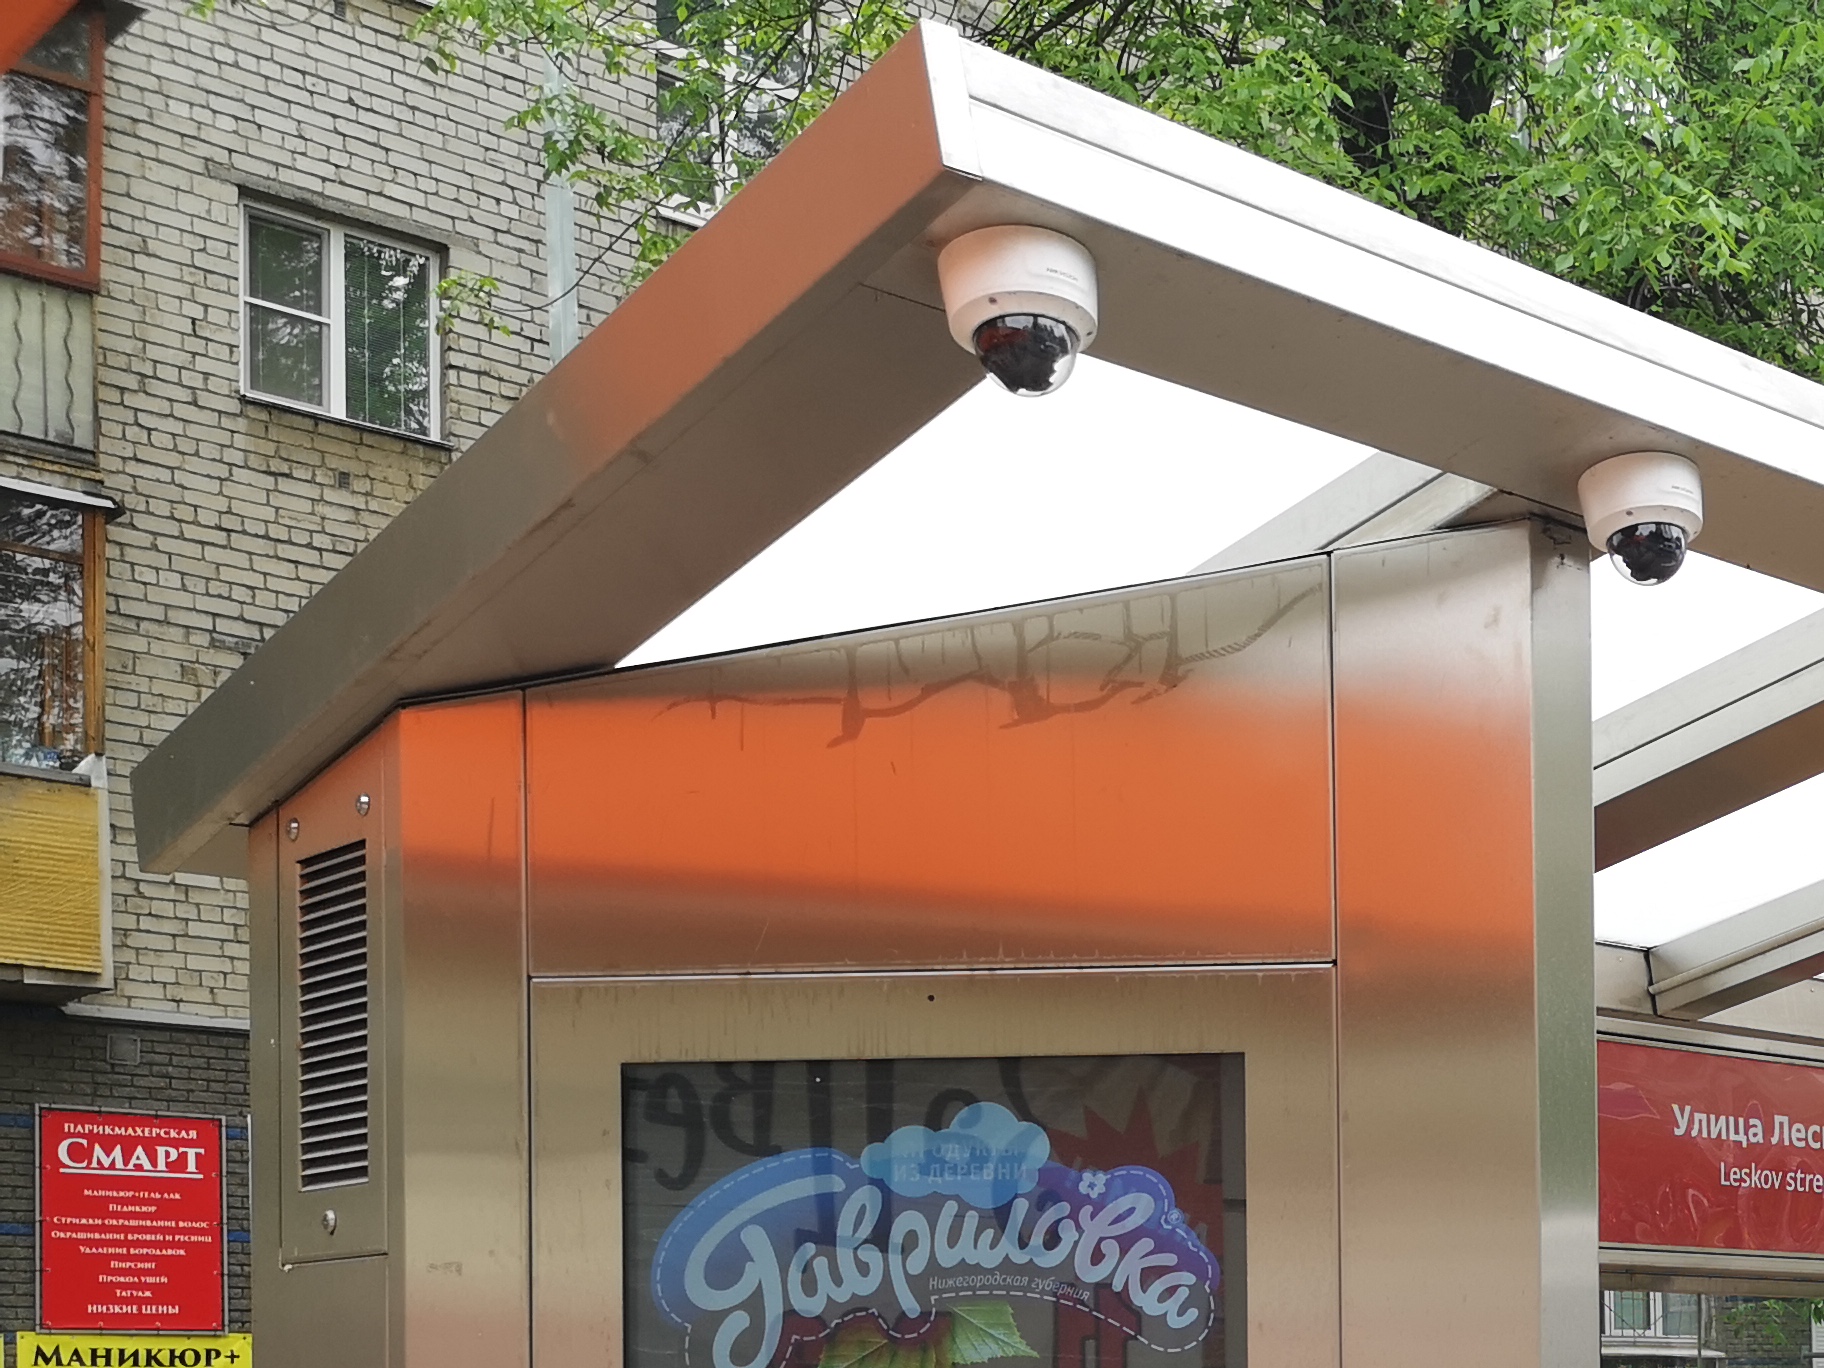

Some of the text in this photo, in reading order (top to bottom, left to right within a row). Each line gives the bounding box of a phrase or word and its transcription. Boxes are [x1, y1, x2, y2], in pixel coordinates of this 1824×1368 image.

[63, 1122, 198, 1140] ПАРИКМАХЕРСКАЯ
[1671, 1103, 1764, 1148] Улица
[57, 1137, 205, 1173] СМАРТ
[892, 1162, 1028, 1185] ИЗ ДЕРЕВНИ
[1720, 1161, 1782, 1190] Leskov
[108, 1203, 157, 1213] ПЕДИКЮР
[110, 1260, 156, 1270] ПИРСИНГ
[98, 1275, 168, 1284] ПРОКОЛ УШЕЙ
[928, 1270, 1091, 1302] Нижегородская губерния
[115, 1289, 153, 1297] ТАТУАЖ
[87, 1304, 180, 1314] НИЗКИЕ ЦЕНЫ
[31, 1343, 241, 1368] МАНИКЮР+
